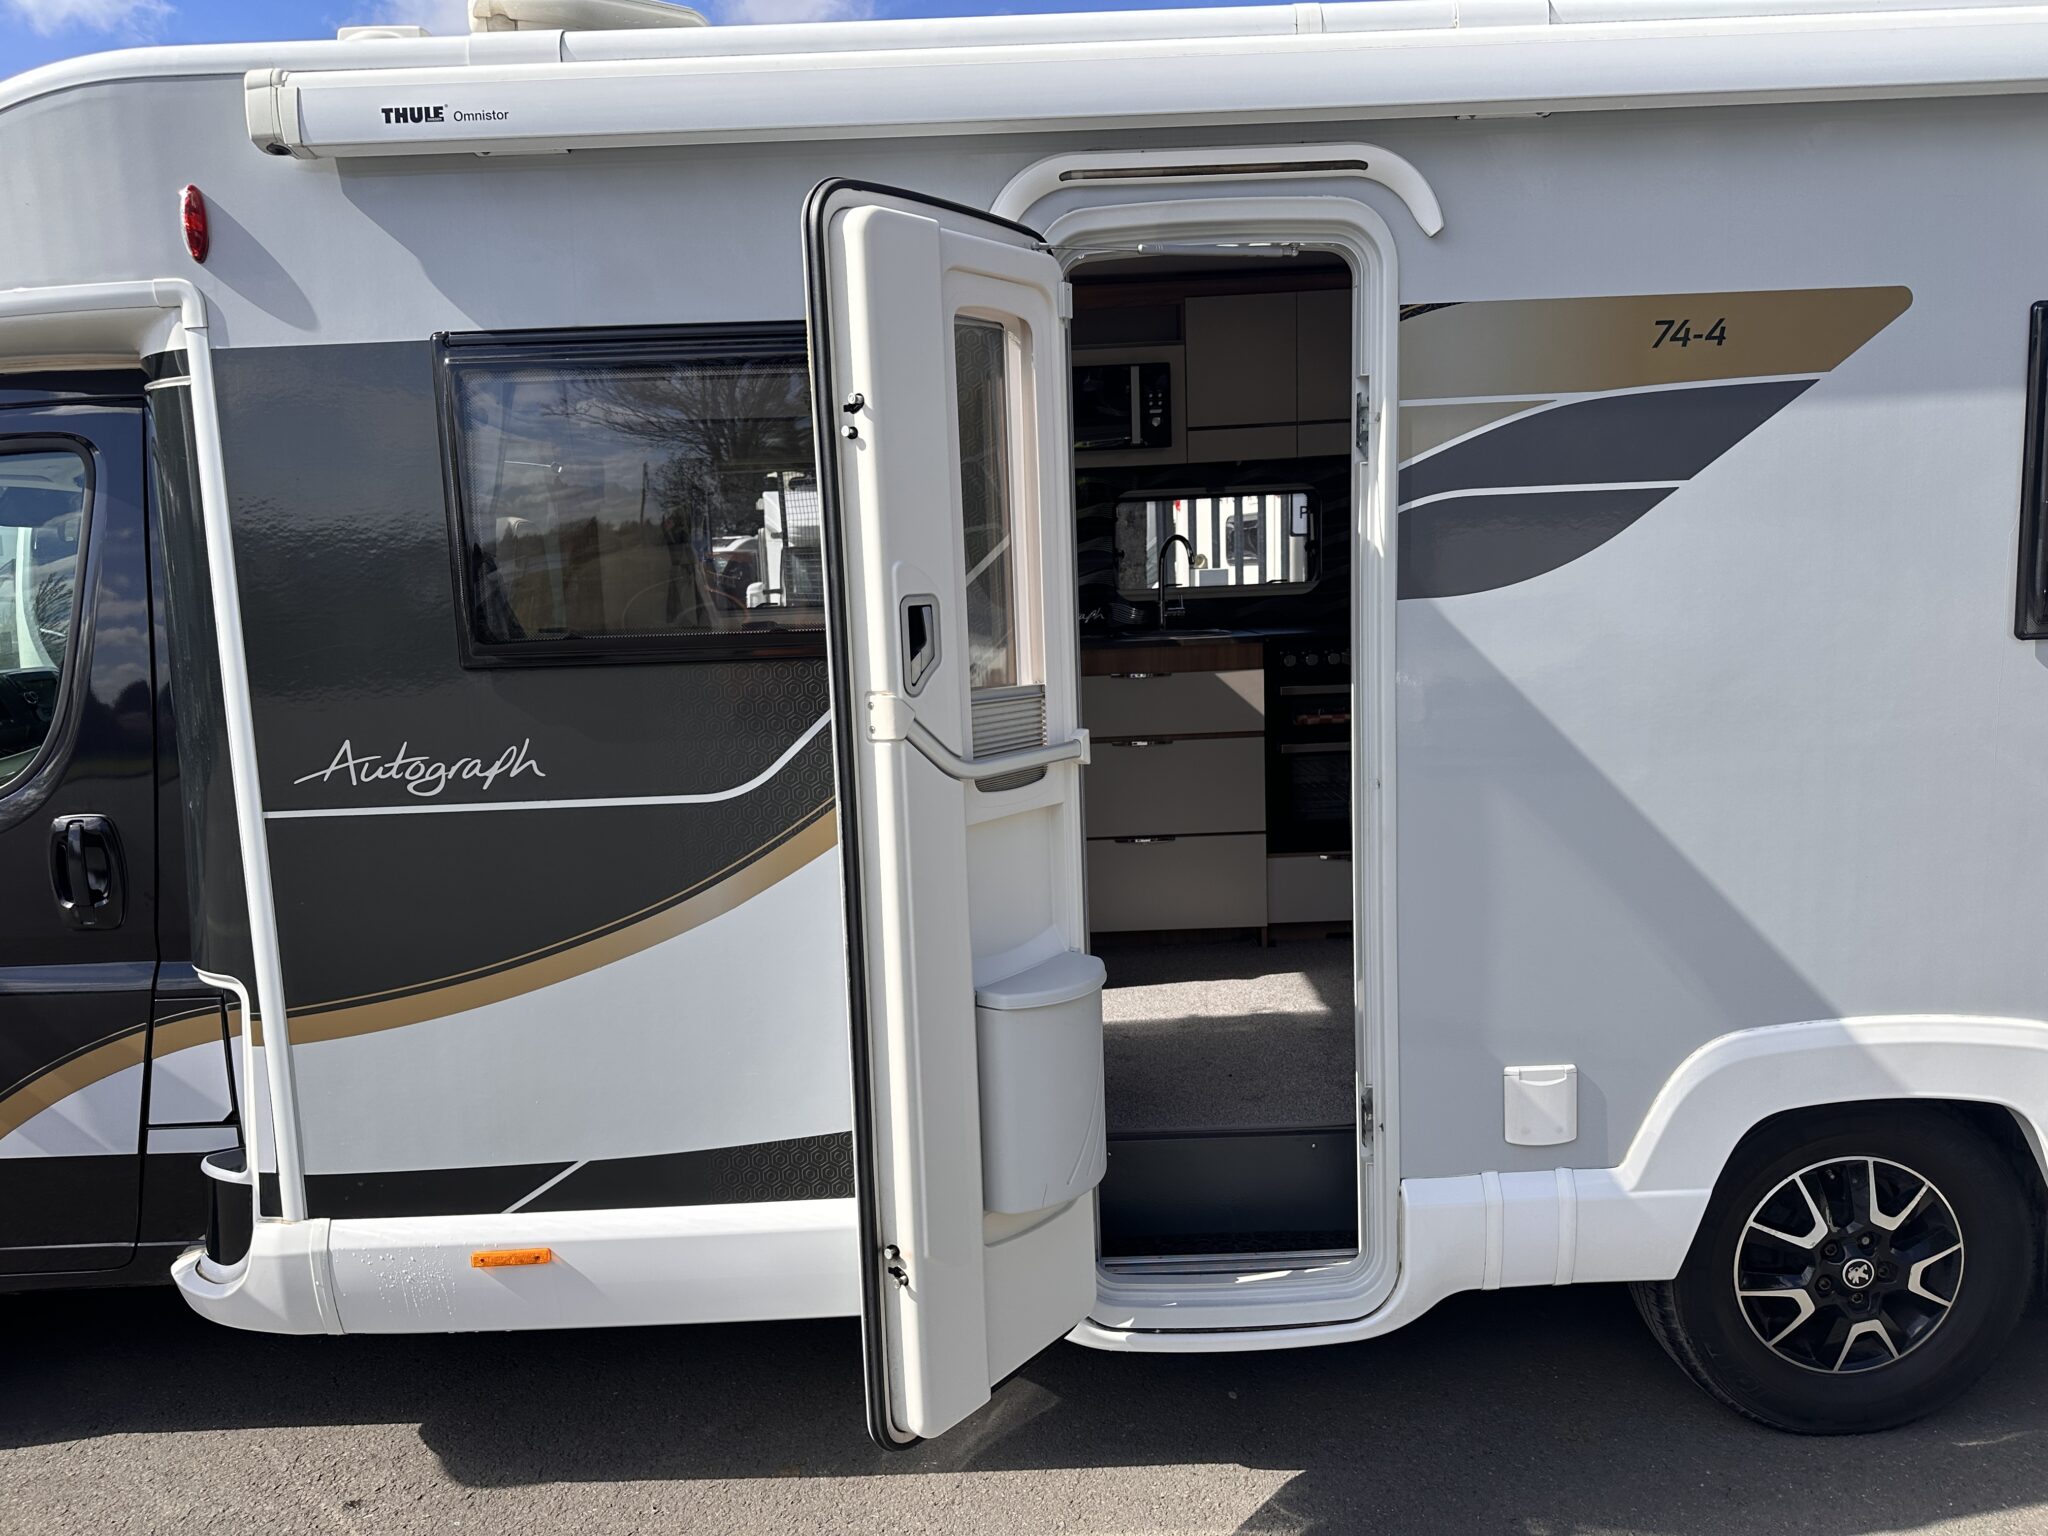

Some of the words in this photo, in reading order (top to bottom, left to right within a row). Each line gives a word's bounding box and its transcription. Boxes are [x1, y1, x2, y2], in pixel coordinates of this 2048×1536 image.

[381, 106, 445, 124] THULE
[453, 110, 510, 122] Omnistor
[1651, 317, 1727, 349] 74-4
[293, 738, 546, 797] Autograph
